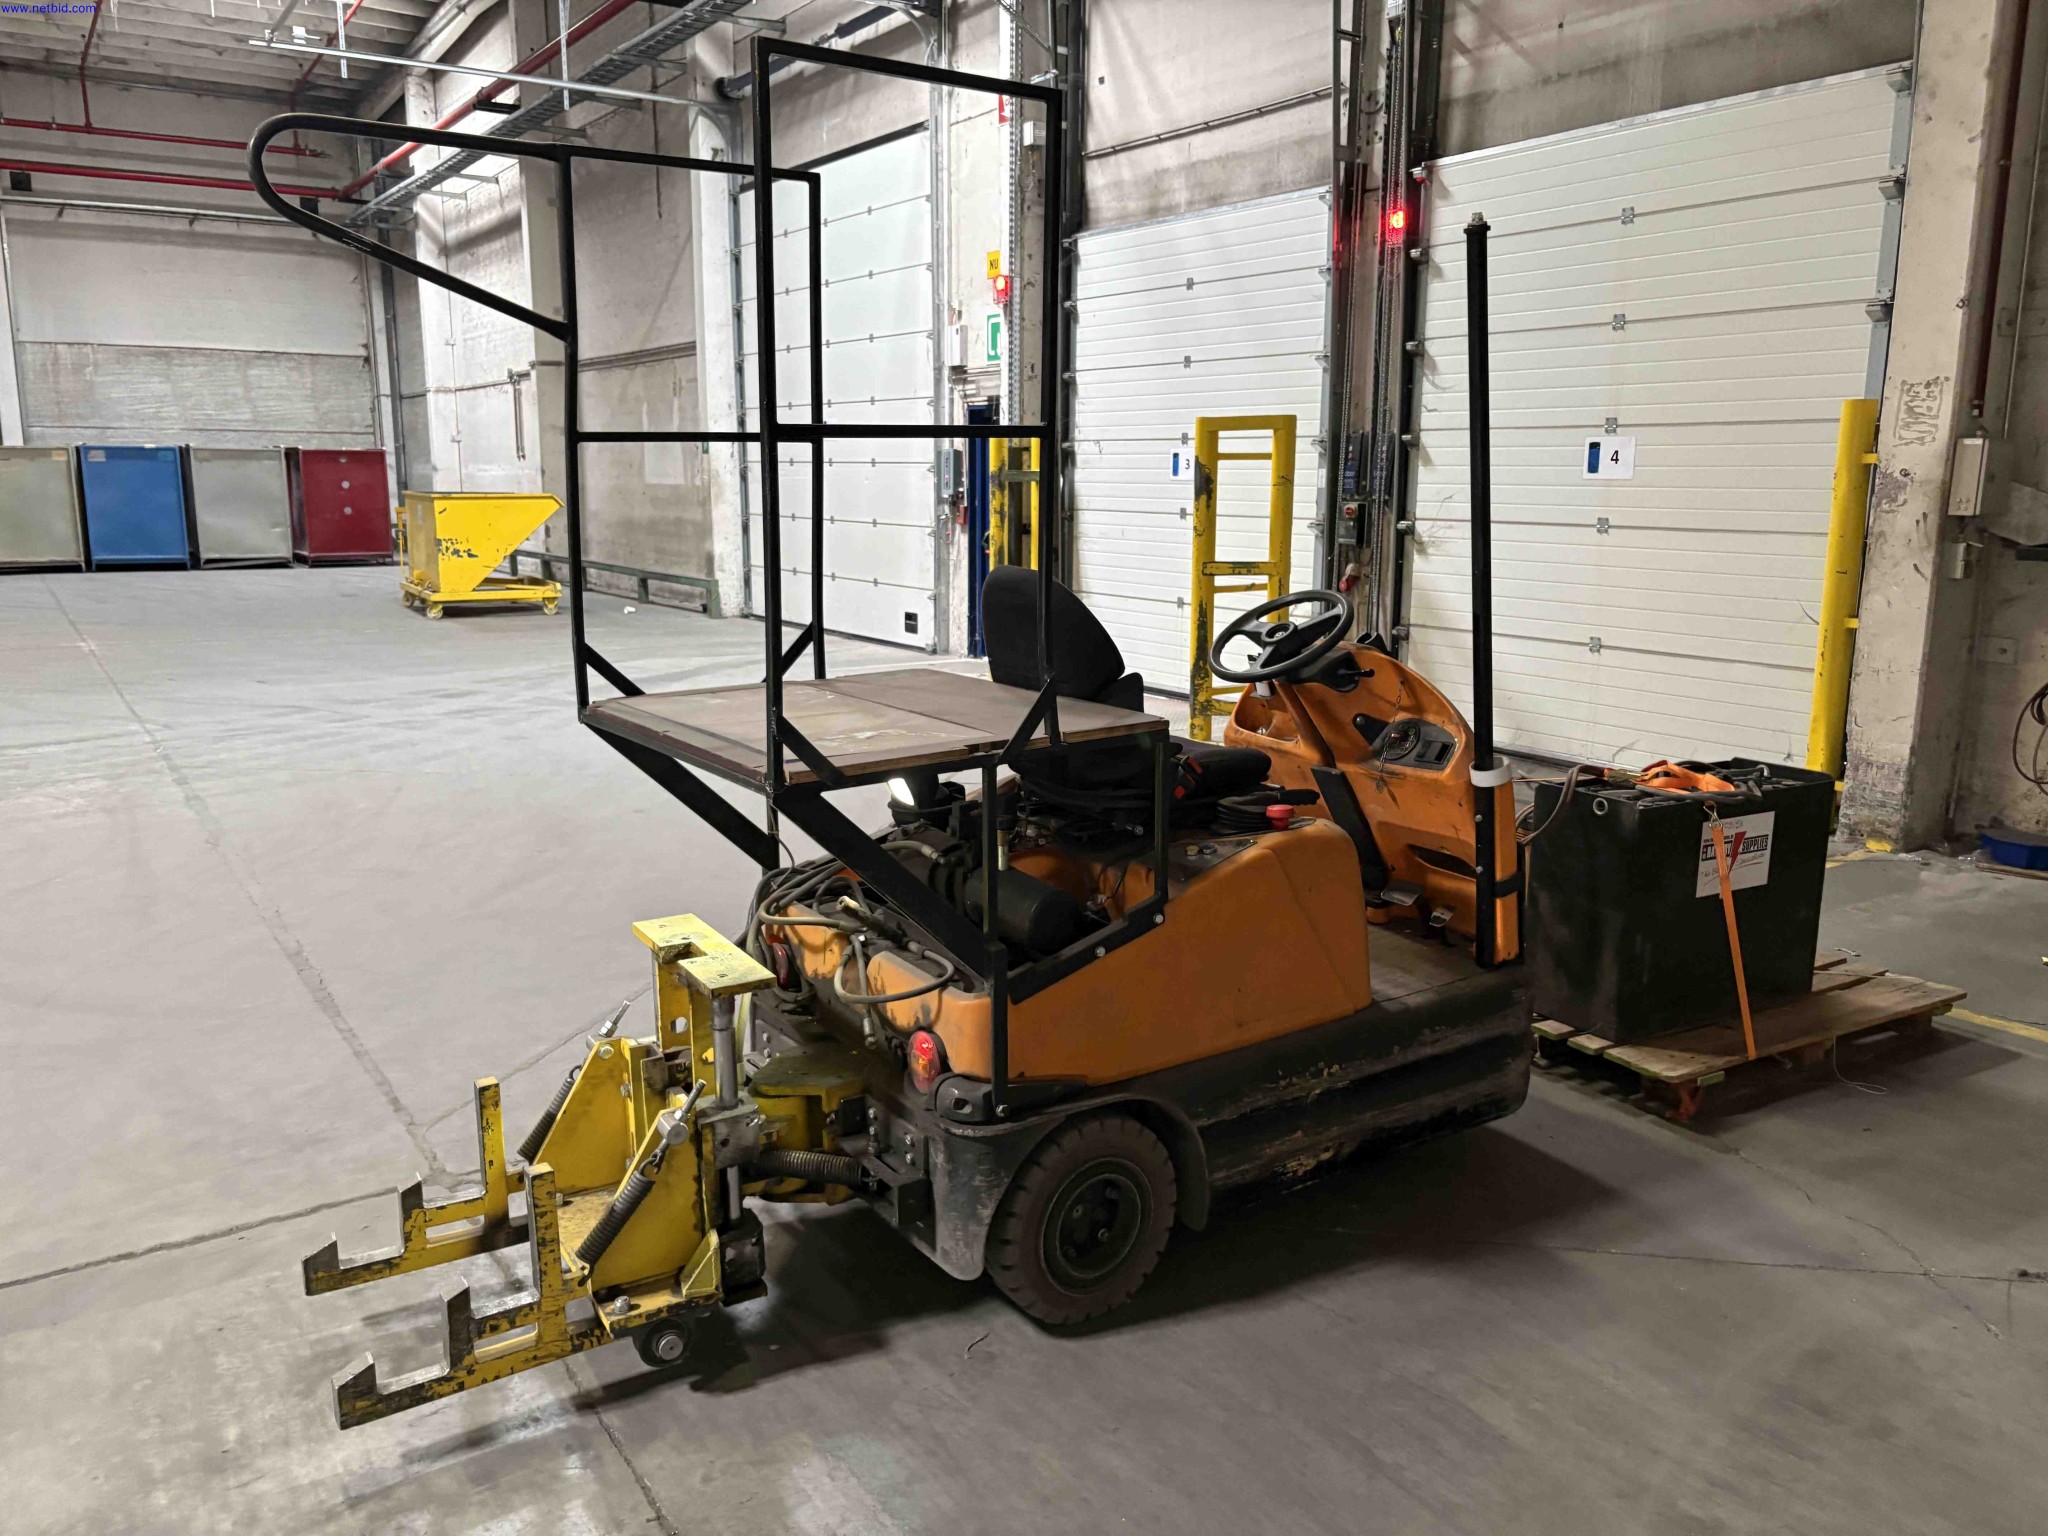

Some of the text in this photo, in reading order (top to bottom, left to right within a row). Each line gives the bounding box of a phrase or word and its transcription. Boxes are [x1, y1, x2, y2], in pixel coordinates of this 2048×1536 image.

[1610, 450, 1620, 464] 4
[1185, 459, 1190, 470] 3
[1741, 837, 1769, 852] SUPPLIES
